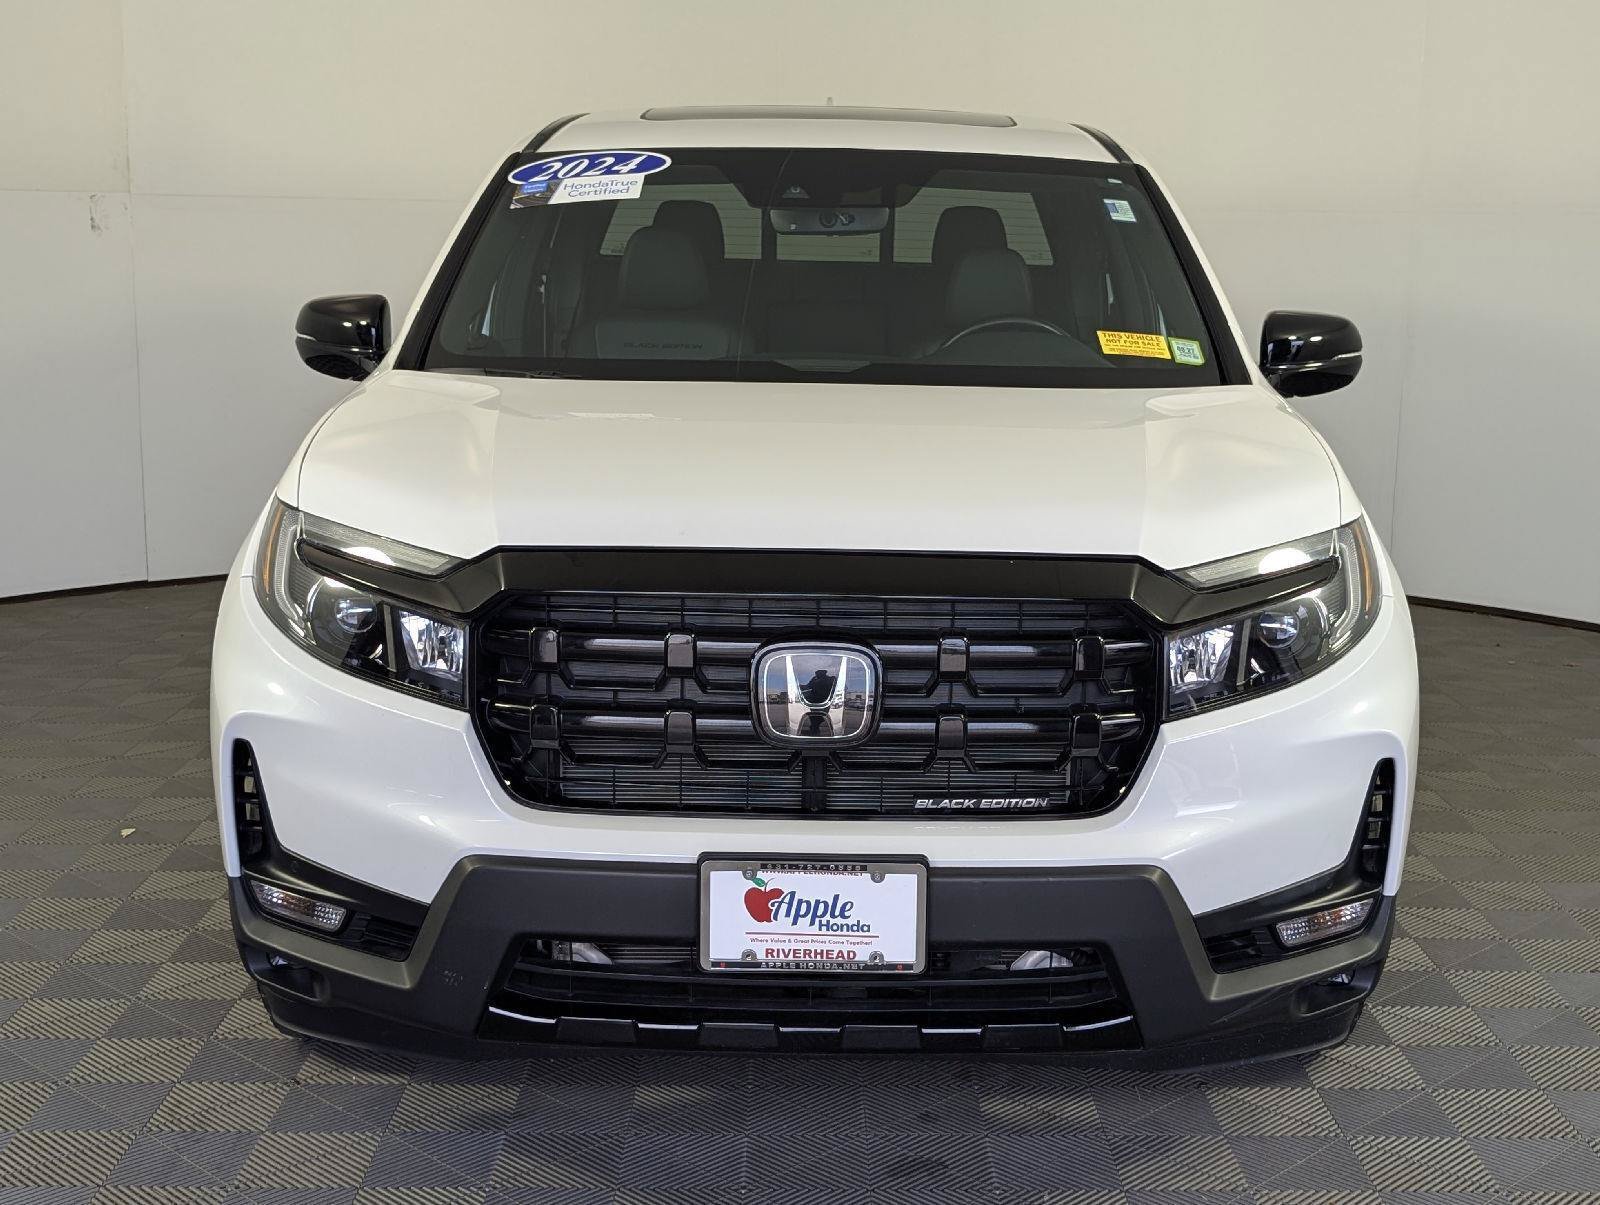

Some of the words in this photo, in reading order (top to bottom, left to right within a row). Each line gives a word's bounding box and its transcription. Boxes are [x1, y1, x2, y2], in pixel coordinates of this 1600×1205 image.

[527, 154, 649, 182] 2024
[563, 179, 638, 191] HondaTrue
[568, 186, 630, 198] Certified
[1101, 332, 1123, 340] THIS
[1124, 333, 1162, 343] VEHICLE
[1141, 340, 1161, 348] SALE
[914, 799, 977, 809] BLACK
[979, 797, 1049, 809] EDITION
[770, 890, 855, 927] Apple
[817, 919, 871, 933] Honda
[846, 939, 873, 947] Together!
[764, 947, 857, 961] RIVERHEAD
[799, 962, 866, 970] HONDA.NET
